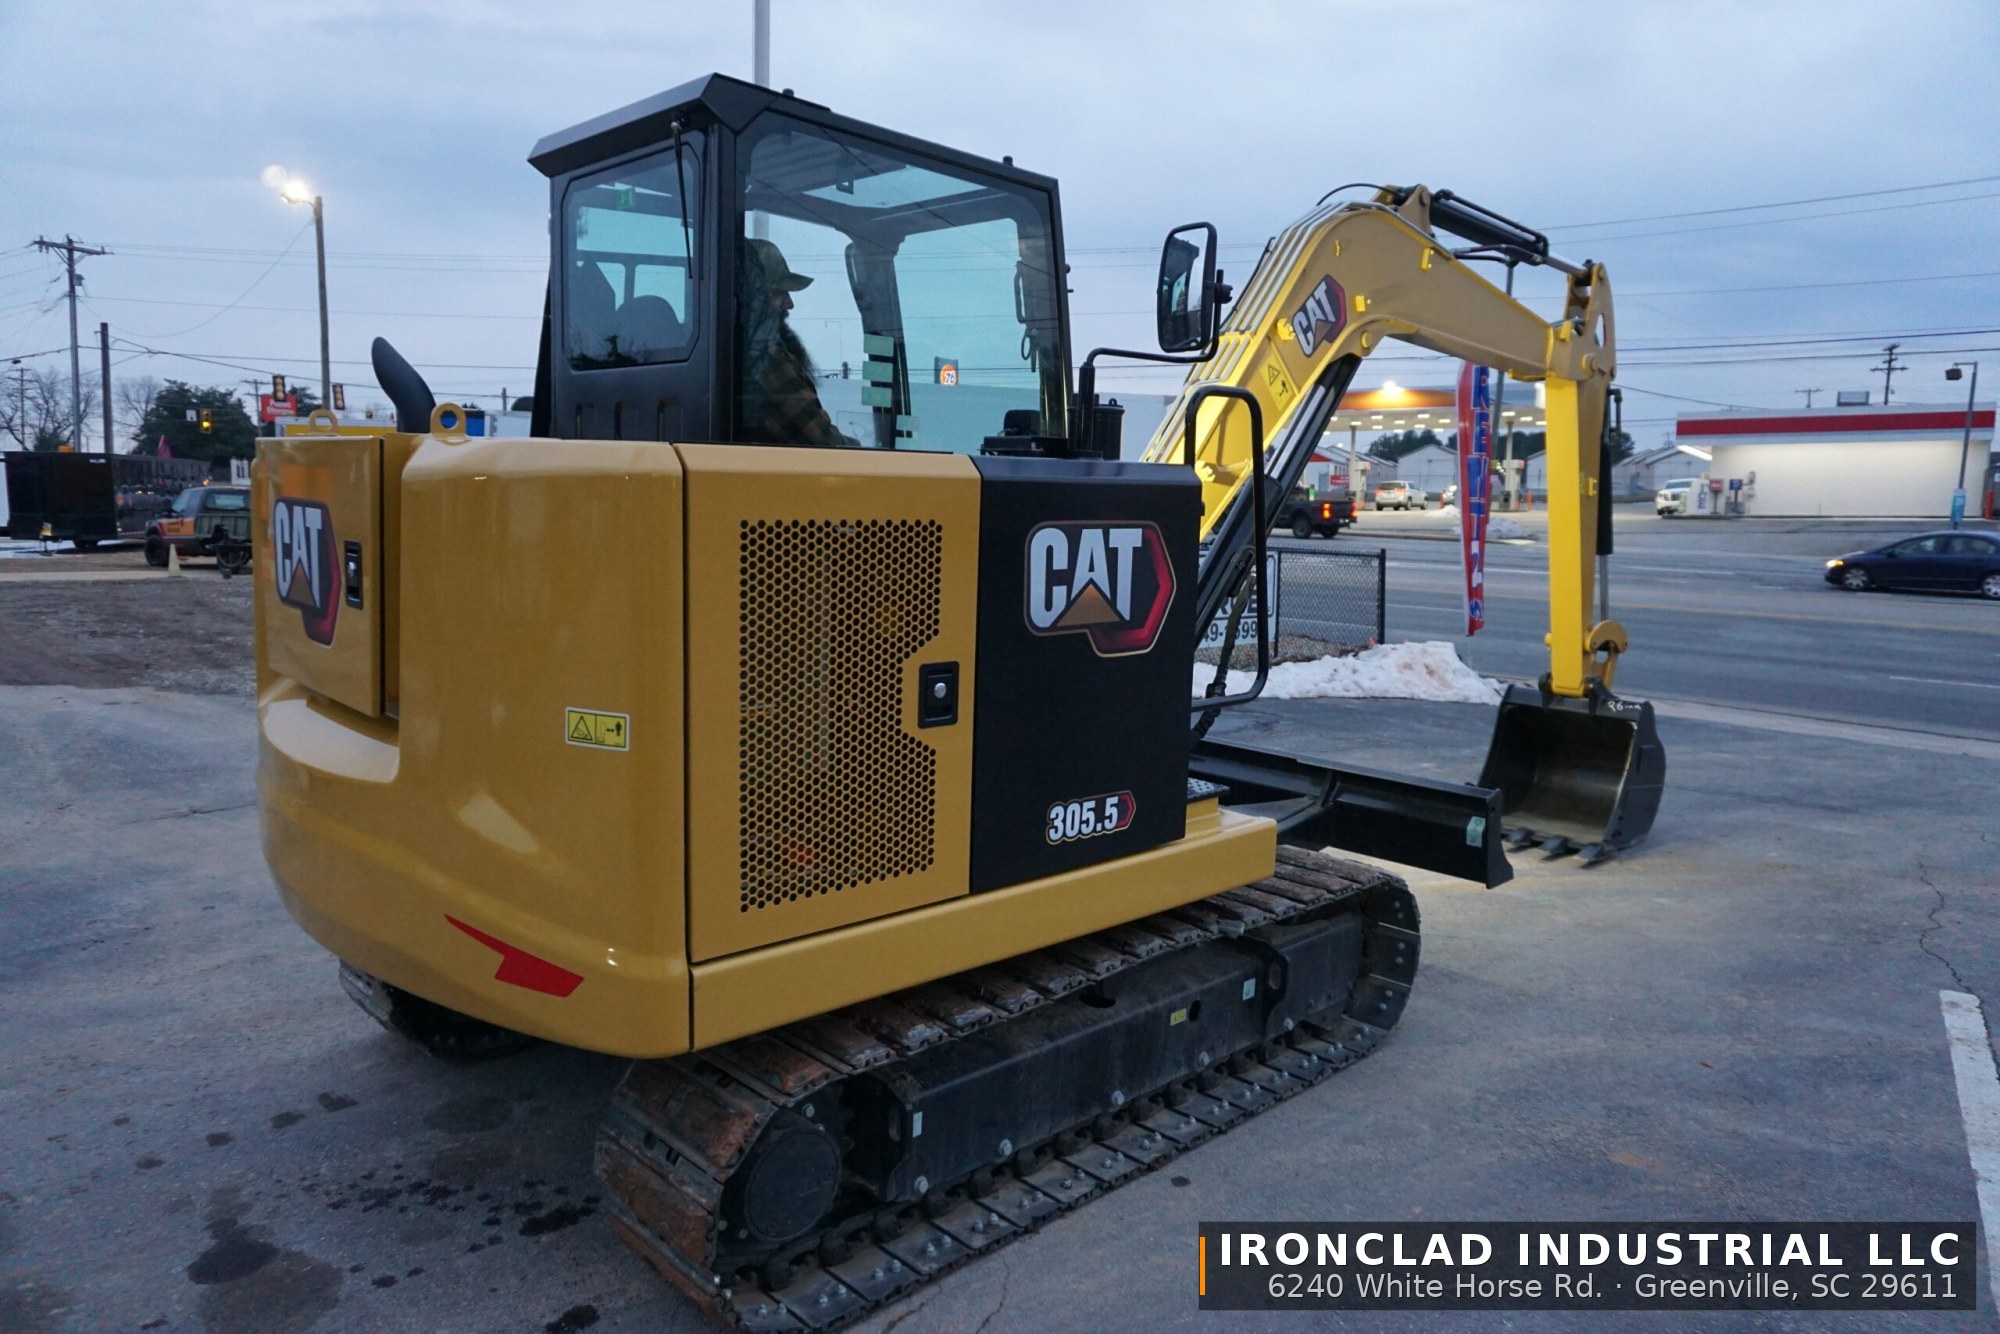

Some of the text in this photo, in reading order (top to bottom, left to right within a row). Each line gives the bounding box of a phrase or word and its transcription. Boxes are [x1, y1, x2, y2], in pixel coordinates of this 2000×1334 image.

[1293, 280, 1337, 355] CAT
[945, 372, 955, 384] 76
[274, 501, 323, 609] CAT
[1030, 527, 1143, 628] CAT
[1049, 796, 1119, 841] 305.5
